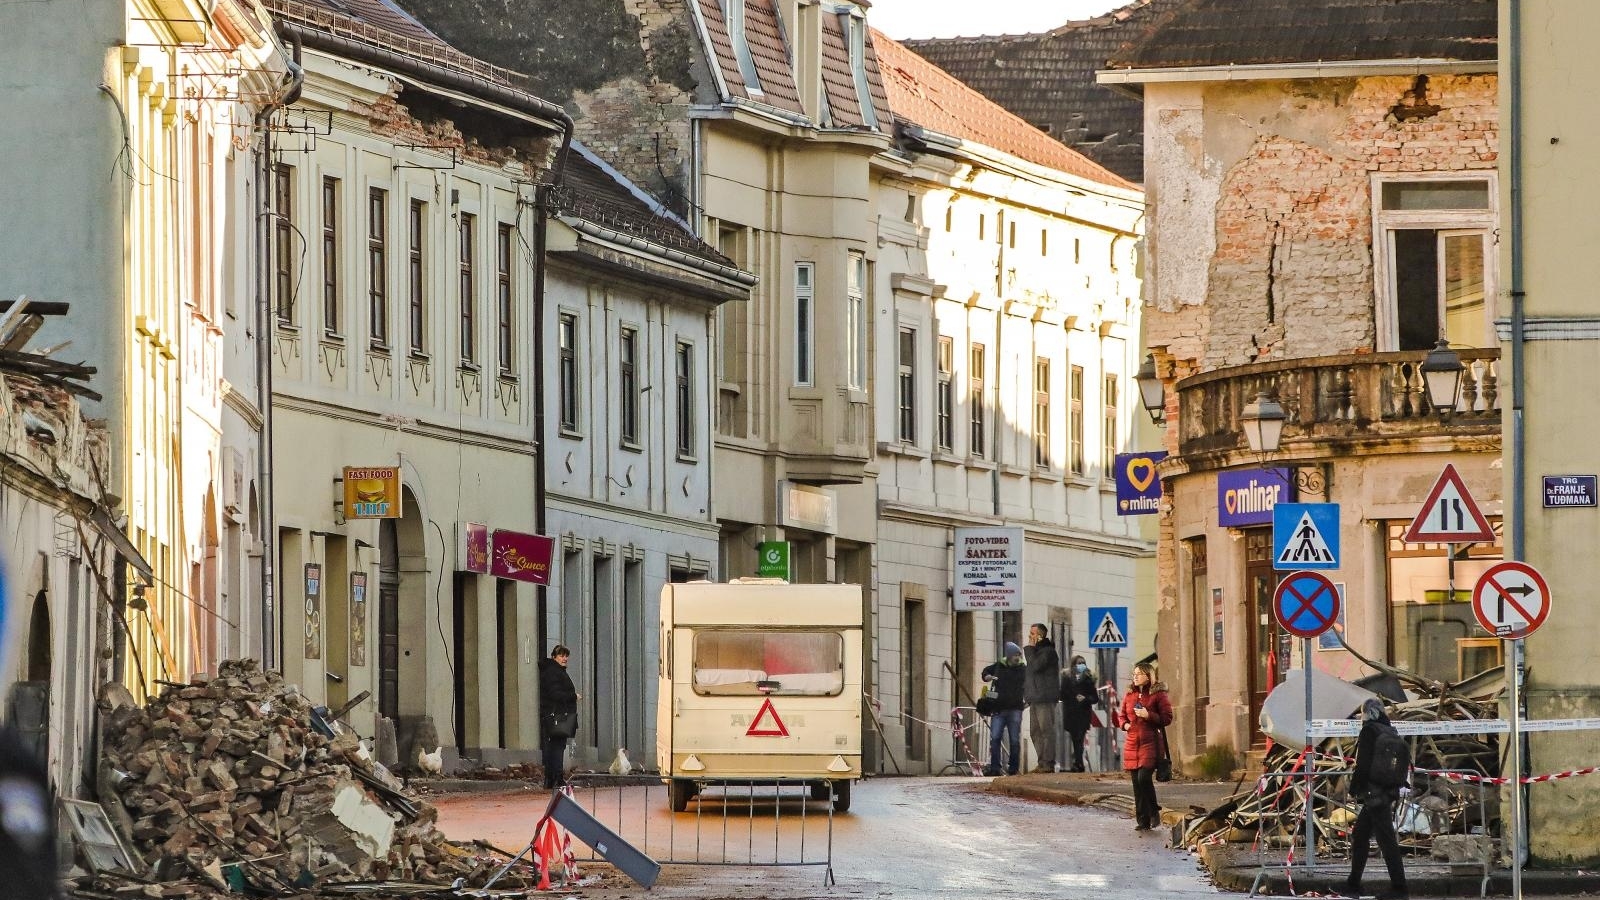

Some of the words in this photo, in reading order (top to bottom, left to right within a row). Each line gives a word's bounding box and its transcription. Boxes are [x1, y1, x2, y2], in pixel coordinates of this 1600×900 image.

[348, 471, 368, 479] FAST
[370, 470, 393, 478] FOOD
[1554, 485, 1586, 495] FRANJE
[1236, 480, 1280, 514] mlinar
[1549, 495, 1590, 505] TUĐMANA
[965, 537, 1009, 545] FOTO-VIDEO
[966, 547, 1007, 559] ŠANTEK
[516, 556, 547, 571] Sunce
